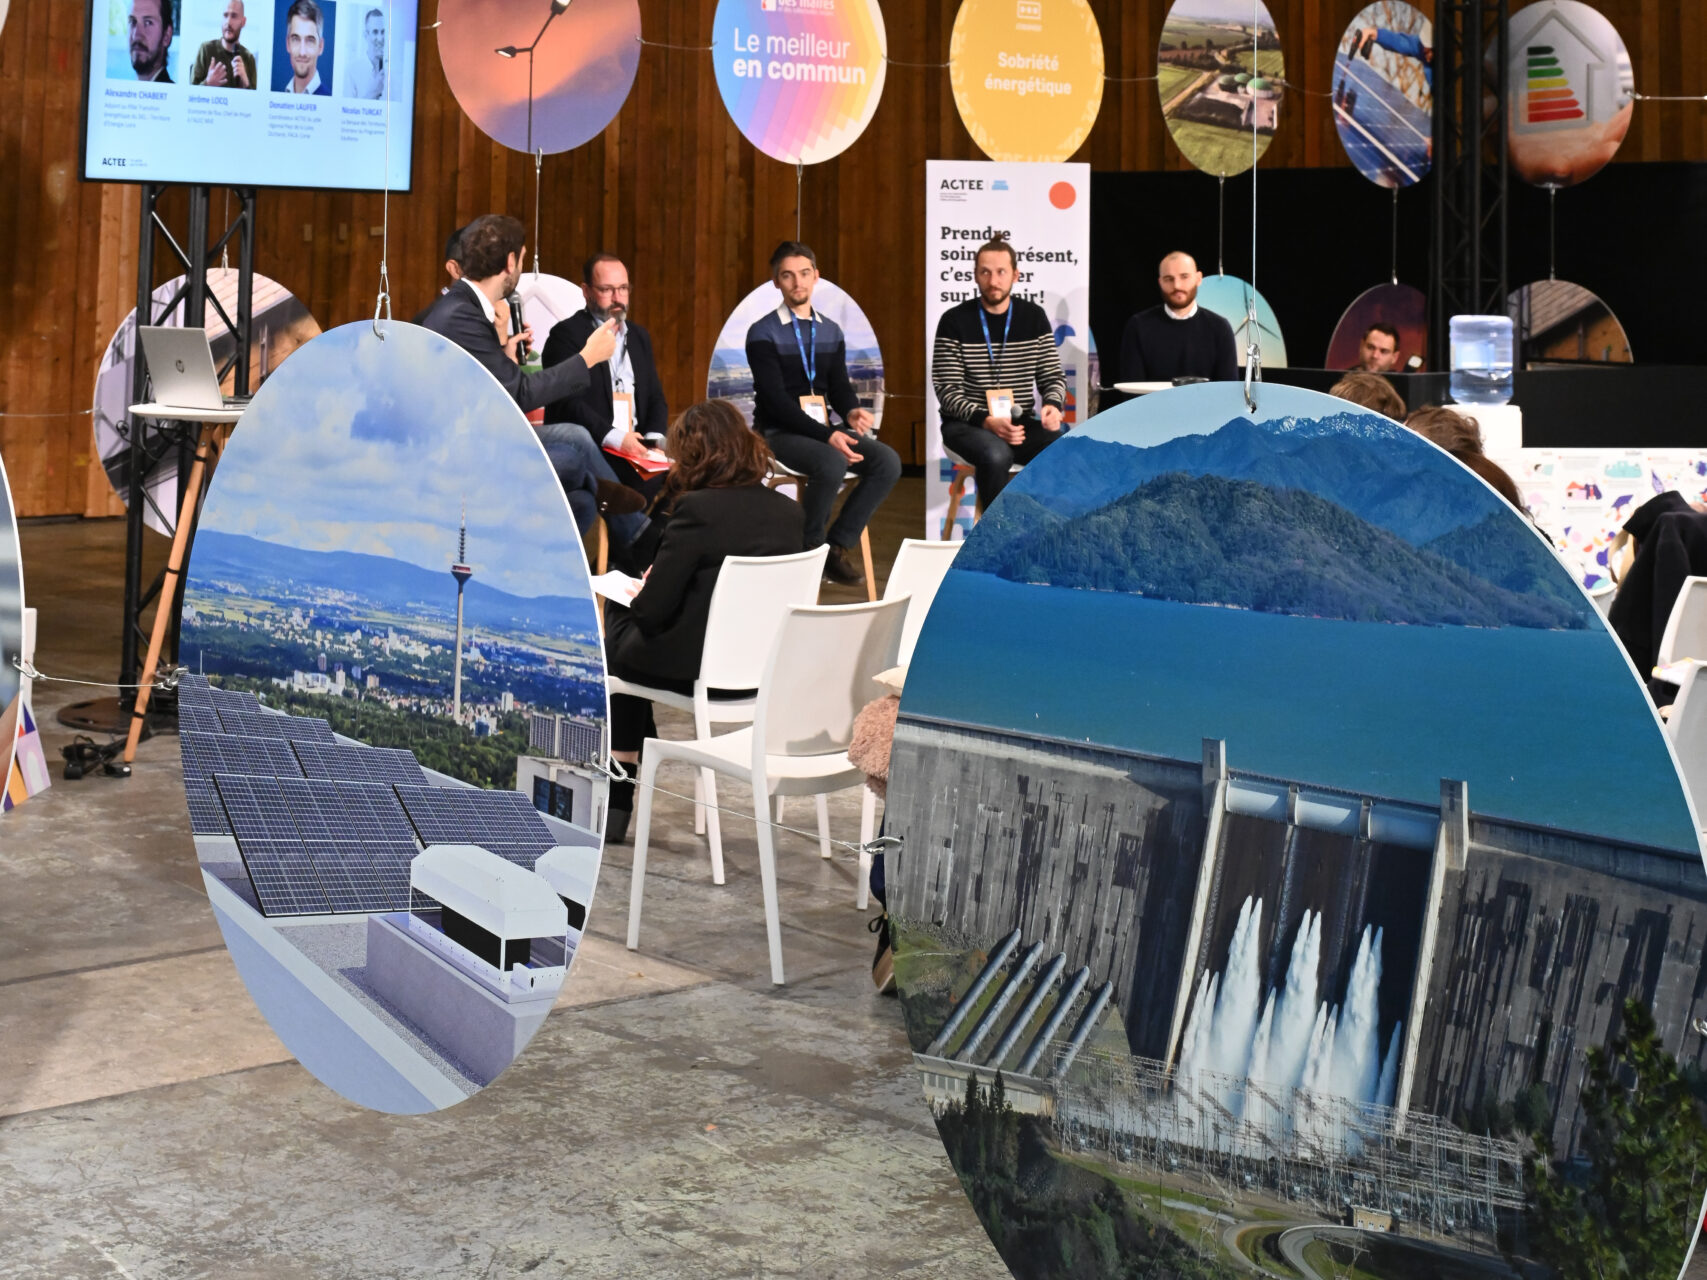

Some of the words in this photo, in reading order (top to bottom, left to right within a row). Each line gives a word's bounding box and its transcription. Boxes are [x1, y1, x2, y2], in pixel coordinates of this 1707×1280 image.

[734, 27, 760, 53] Le
[766, 32, 851, 59] meilleur
[998, 51, 1059, 71] Sobriété
[733, 57, 762, 78] en
[767, 60, 867, 85] commun
[984, 73, 1072, 97] énergétique
[102, 157, 126, 167] ACTEE
[940, 179, 984, 191] ACTEE
[940, 267, 975, 282] c'es
[940, 291, 969, 302] sur
